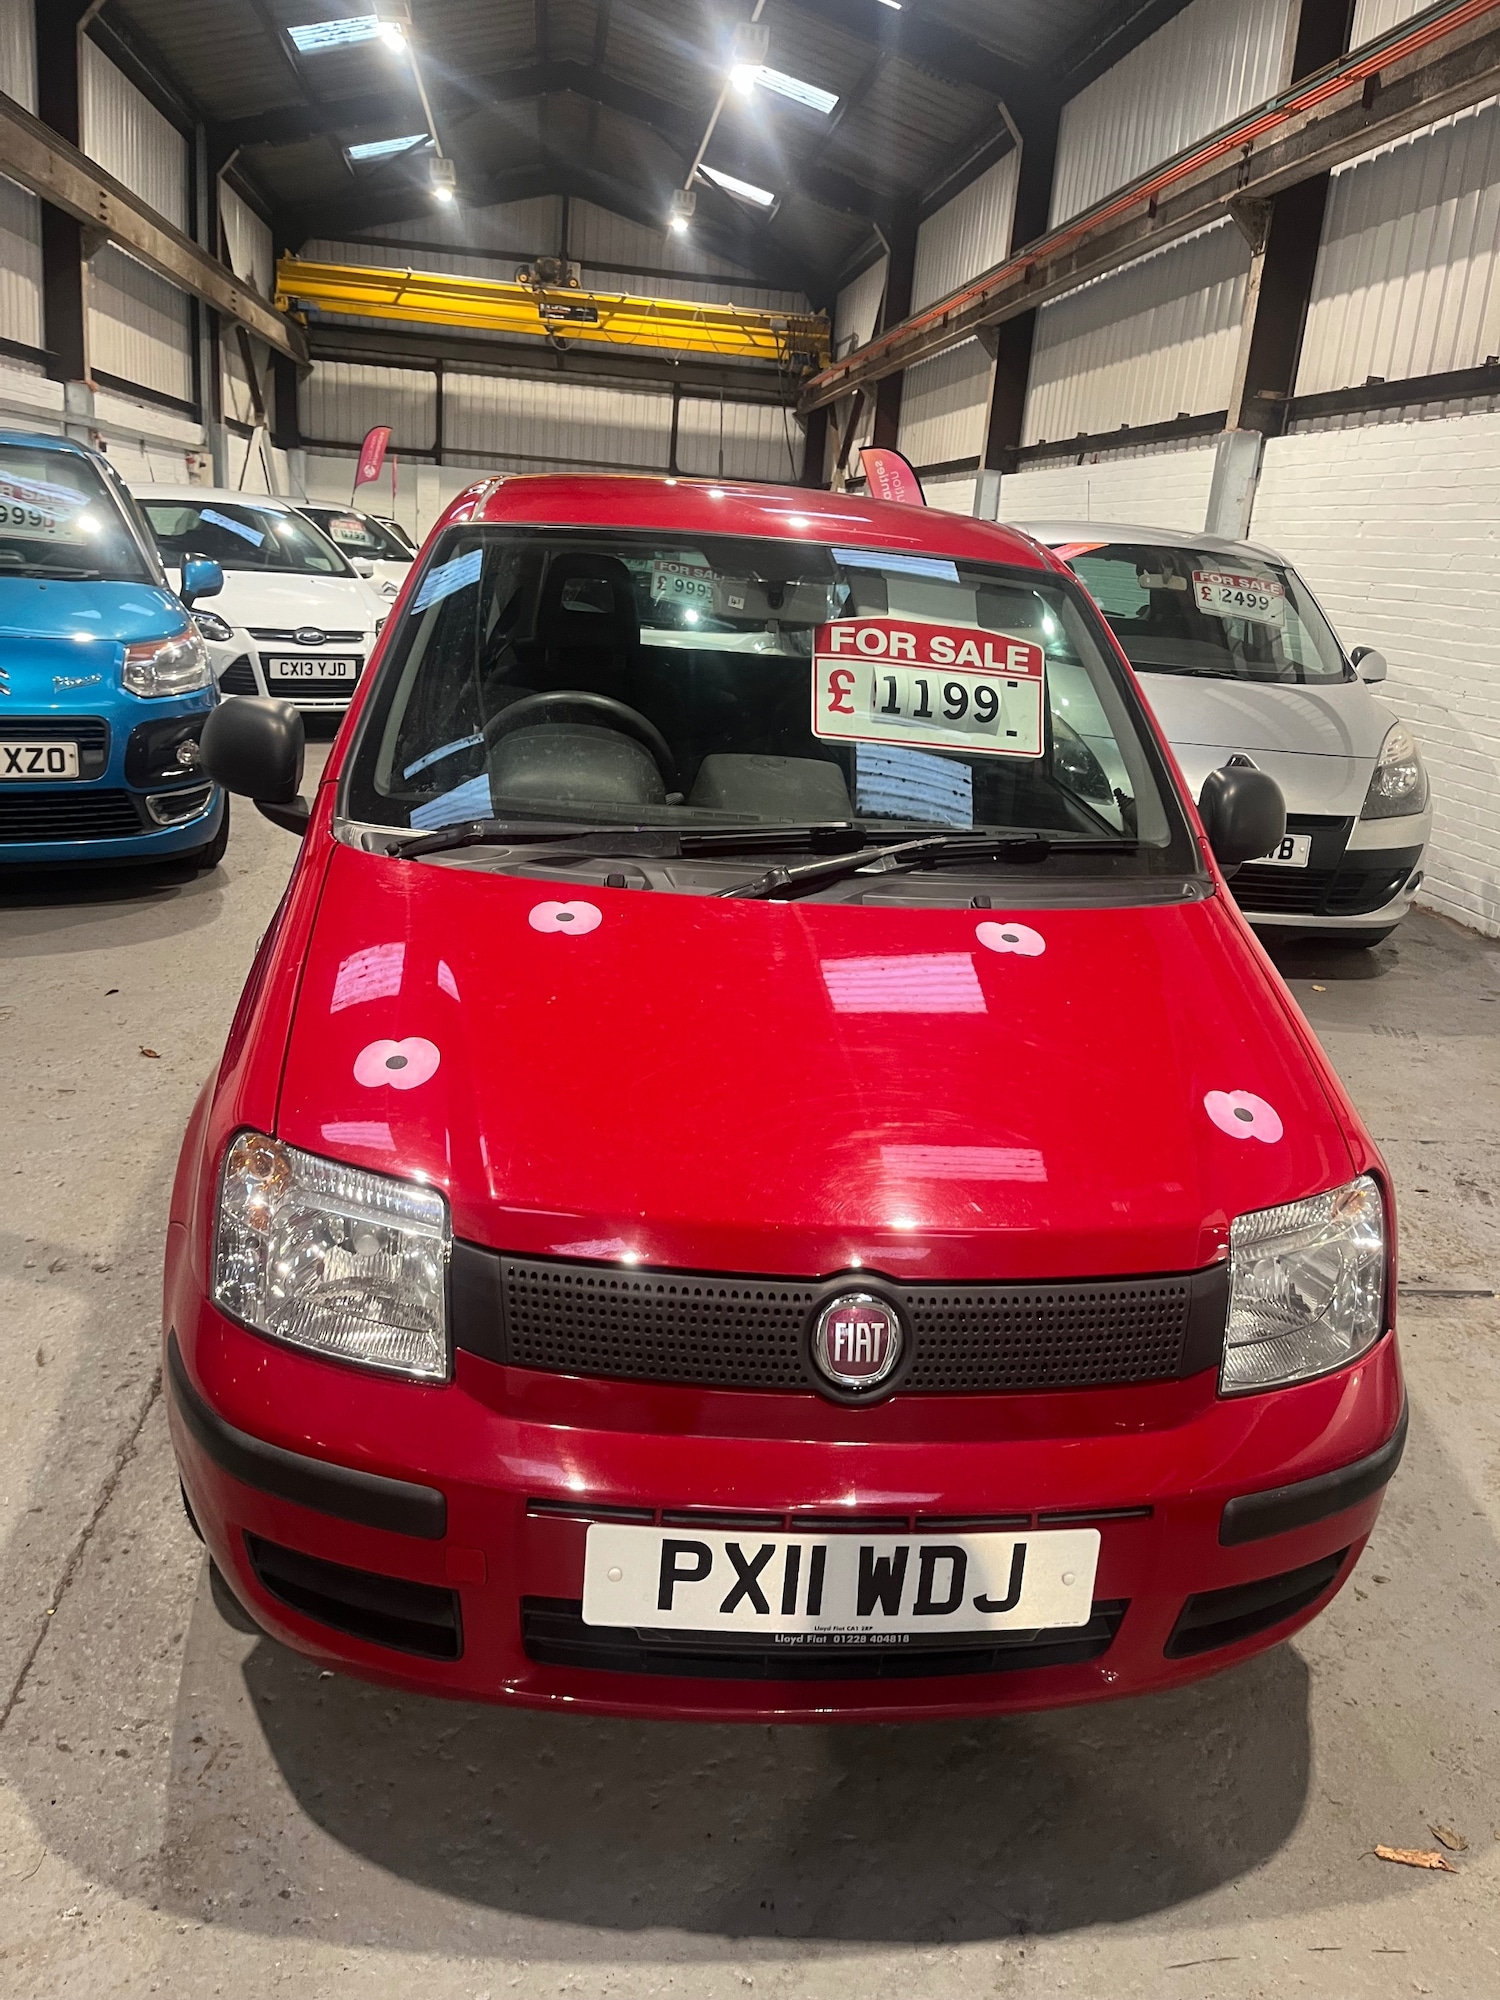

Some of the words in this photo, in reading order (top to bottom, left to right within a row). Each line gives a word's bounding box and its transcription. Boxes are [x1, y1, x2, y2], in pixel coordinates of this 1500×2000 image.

[659, 562, 689, 576] FOR
[1199, 572, 1234, 586] FOR
[1239, 578, 1280, 594] SALE
[1201, 586, 1213, 602] £
[1221, 588, 1269, 610] 2499
[830, 626, 917, 660] FOR
[930, 636, 1030, 673] SALE
[280, 662, 313, 676] CX13
[318, 662, 346, 676] YJD
[827, 668, 856, 714] £
[880, 675, 999, 724] 1199
[3, 748, 66, 773] XZO
[834, 1322, 885, 1363] FIAT
[656, 1538, 828, 1616] PX11
[855, 1542, 1028, 1617] WDJ
[774, 1634, 804, 1645] Lloyd
[806, 1634, 827, 1643] Fiat
[833, 1635, 867, 1643] 01228
[869, 1634, 910, 1643] 404818
